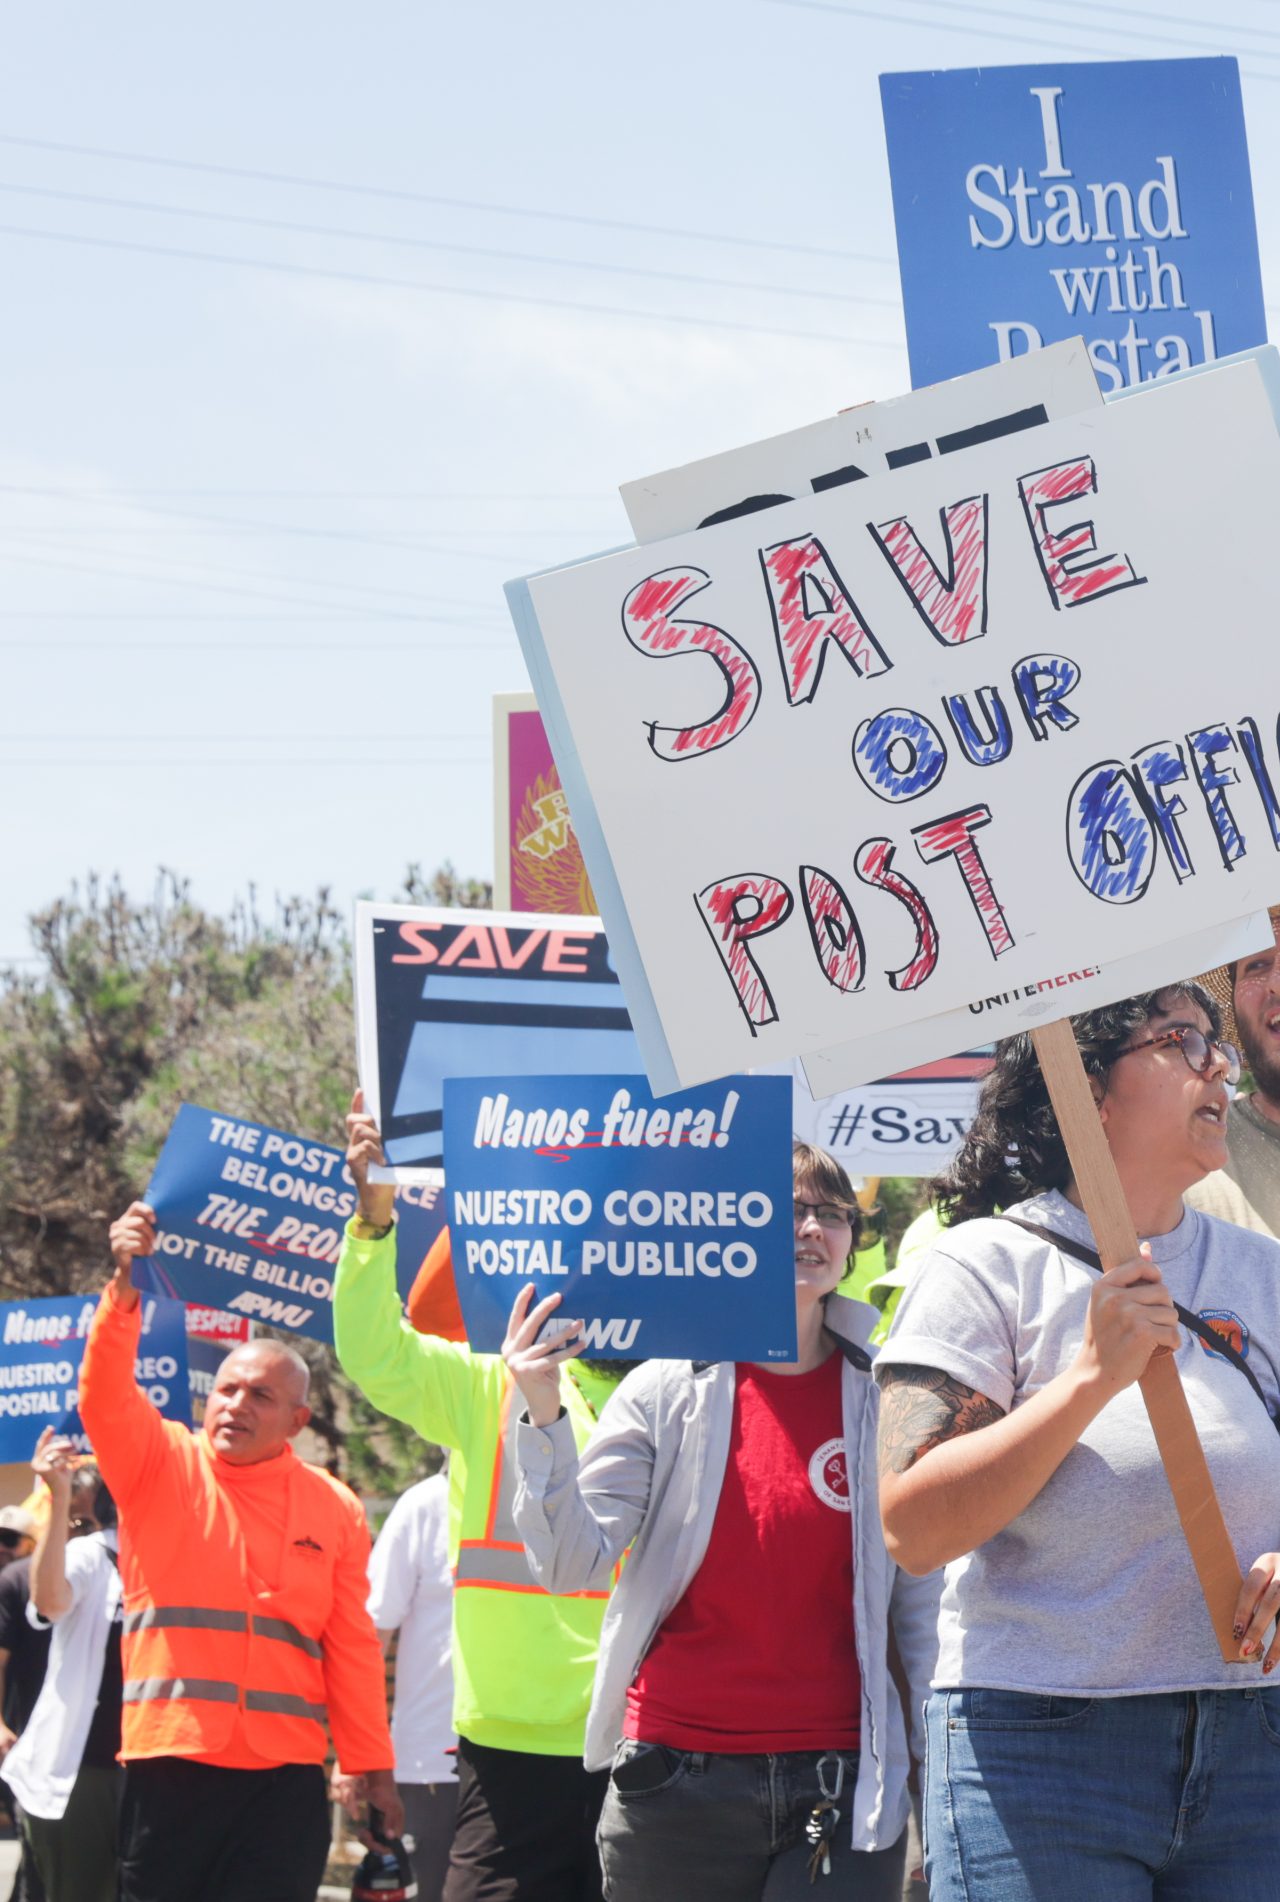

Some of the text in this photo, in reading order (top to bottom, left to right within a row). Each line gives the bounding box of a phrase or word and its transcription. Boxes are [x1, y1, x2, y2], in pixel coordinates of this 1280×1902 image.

[1030, 87, 1072, 179] I
[965, 155, 1189, 249] Stand
[1050, 246, 1187, 315] with
[989, 311, 1218, 393] Pstal
[620, 455, 1148, 763] SAVE
[852, 654, 1081, 803] OUR
[392, 921, 595, 973] SAVE
[694, 804, 1015, 1037] POST
[208, 1117, 262, 1153] THE
[261, 1133, 340, 1177] POST
[472, 1088, 741, 1149] Manos fuera!
[828, 1104, 976, 1147] #Sav
[220, 1155, 357, 1218] BELONGS
[454, 1189, 774, 1228] NUESTRO CORREO
[196, 1192, 342, 1264] THE PEO
[466, 1239, 758, 1278] POSTAL PUBLICO
[204, 1244, 251, 1276] THE
[252, 1260, 336, 1301] BILLIO
[4, 1309, 72, 1345] Manos
[227, 1291, 314, 1327] APWU
[536, 1317, 642, 1350] APWU
